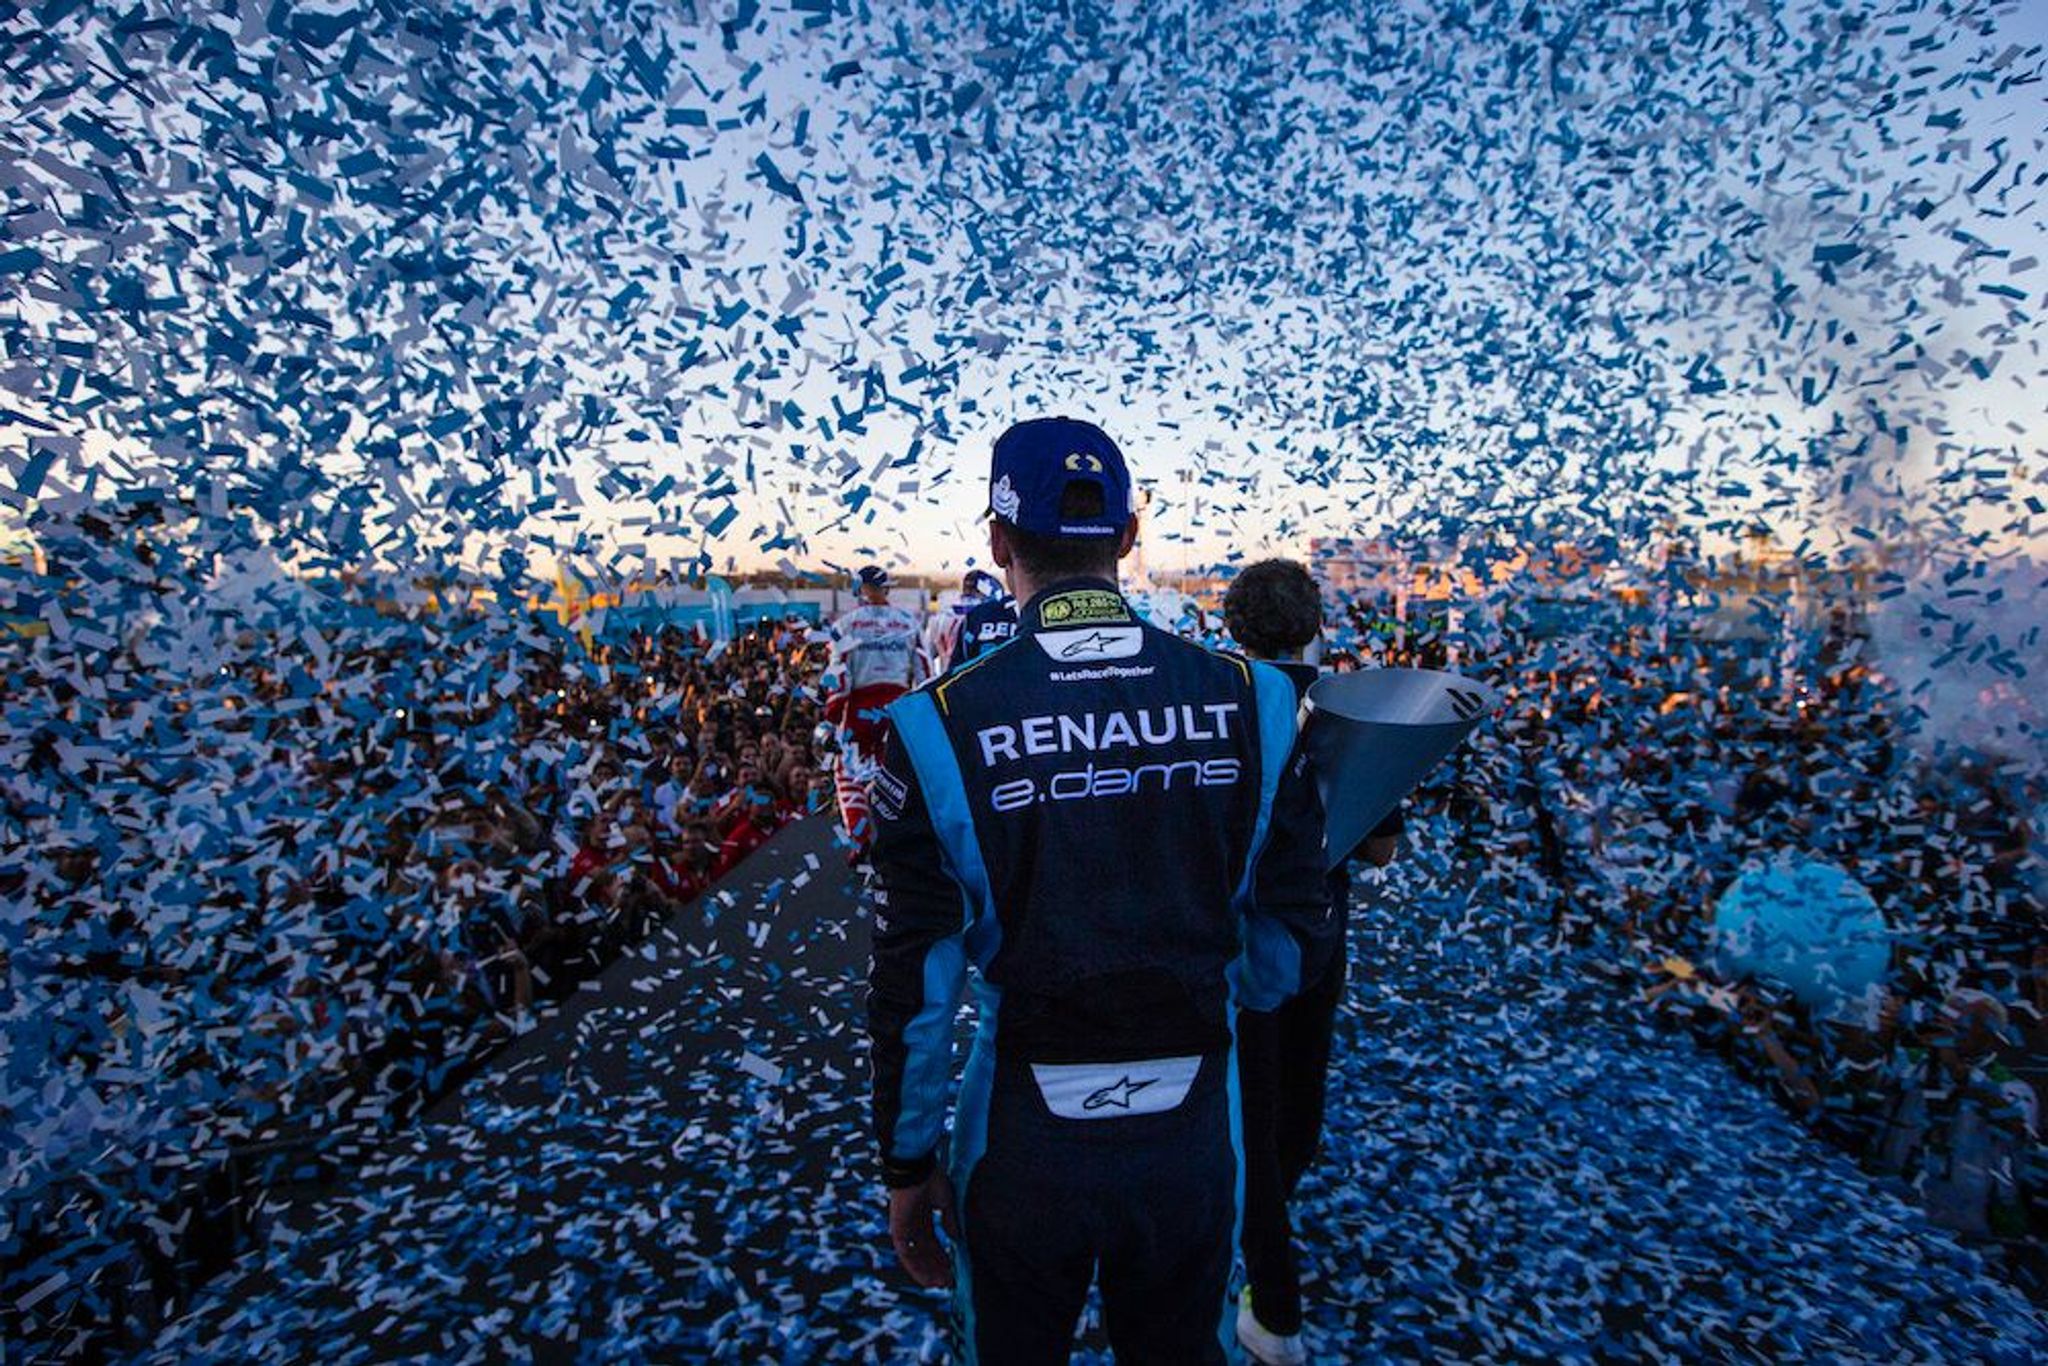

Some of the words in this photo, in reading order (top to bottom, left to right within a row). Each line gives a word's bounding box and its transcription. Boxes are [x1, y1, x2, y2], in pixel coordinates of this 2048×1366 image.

[1049, 666, 1156, 681] #LetsRaceTogether
[977, 703, 1239, 767] RENAULT
[991, 758, 1241, 812] e.dams
